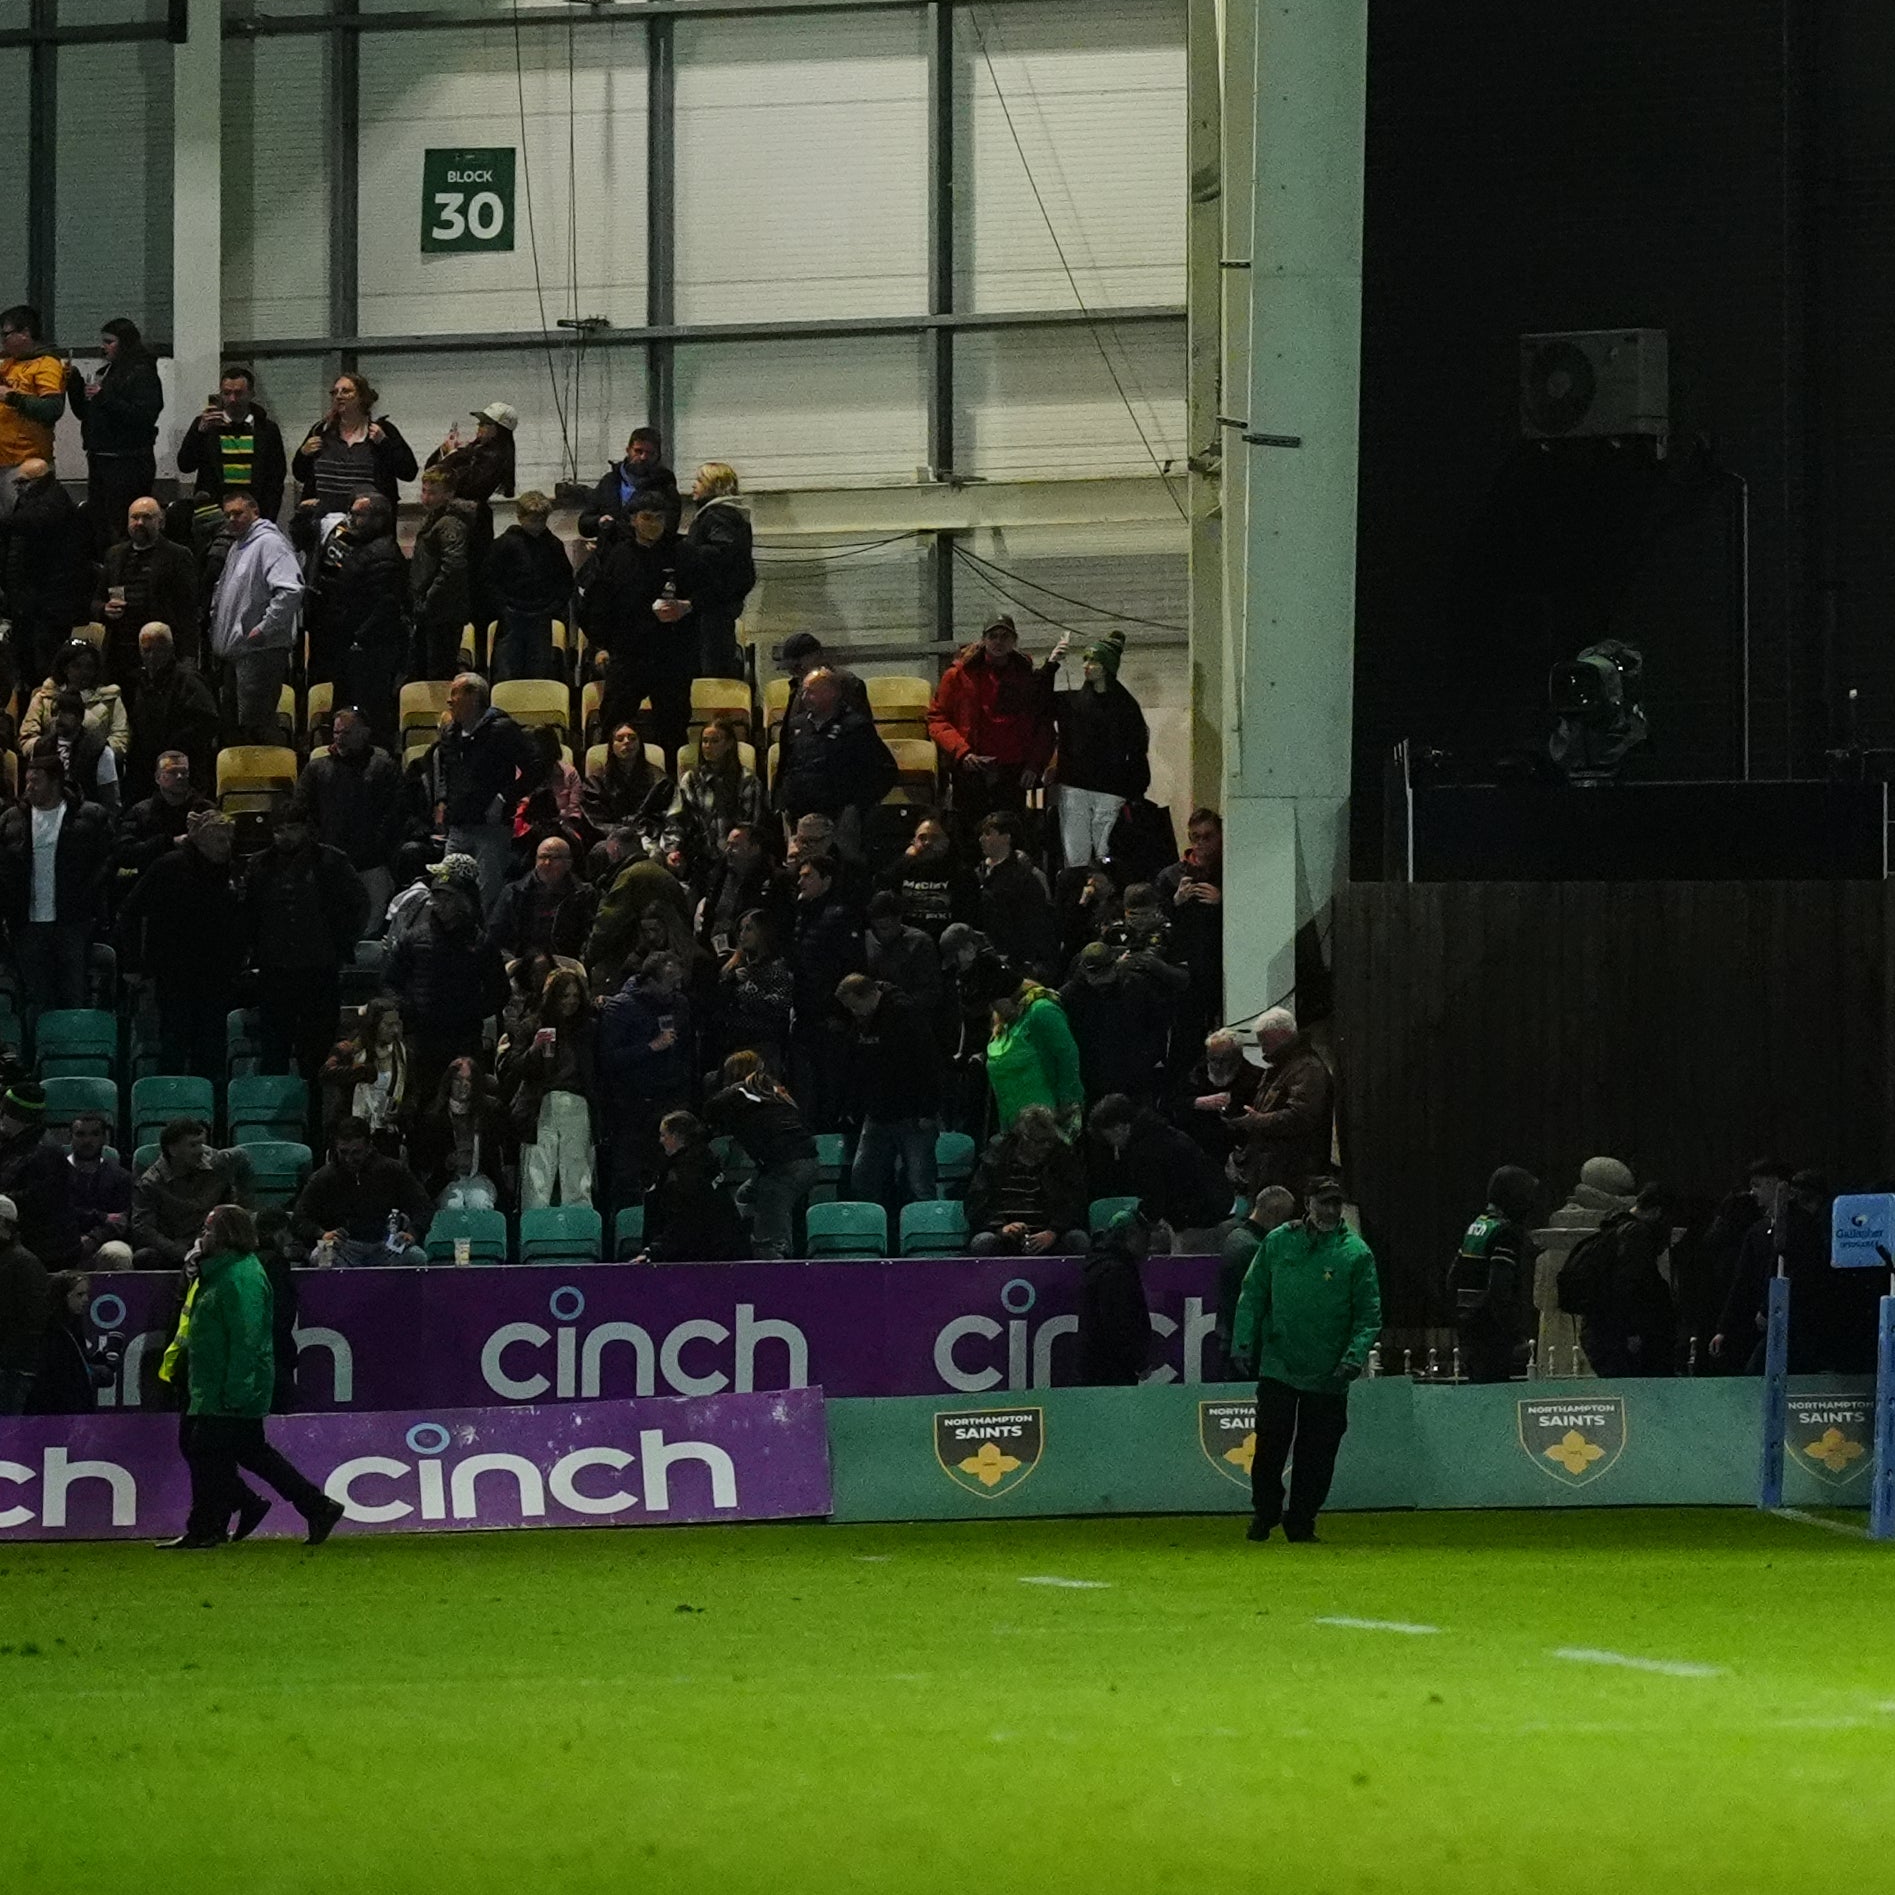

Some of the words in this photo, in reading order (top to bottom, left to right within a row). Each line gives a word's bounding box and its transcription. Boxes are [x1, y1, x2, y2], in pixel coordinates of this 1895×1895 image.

[447, 170, 493, 183] BLOCK
[432, 192, 504, 240] 30
[480, 1285, 809, 1400] cinch
[1208, 1407, 1257, 1416] NORTHA
[1527, 1404, 1616, 1415] NORTHAMPTON
[1787, 1400, 1874, 1411] NORTHAMPTON
[943, 1414, 1033, 1428] NORTHAMPTON
[1538, 1414, 1606, 1428] SAINTS
[1798, 1411, 1866, 1424] SAINTS
[954, 1424, 1023, 1440] SAINTS
[324, 1422, 738, 1525] cinch
